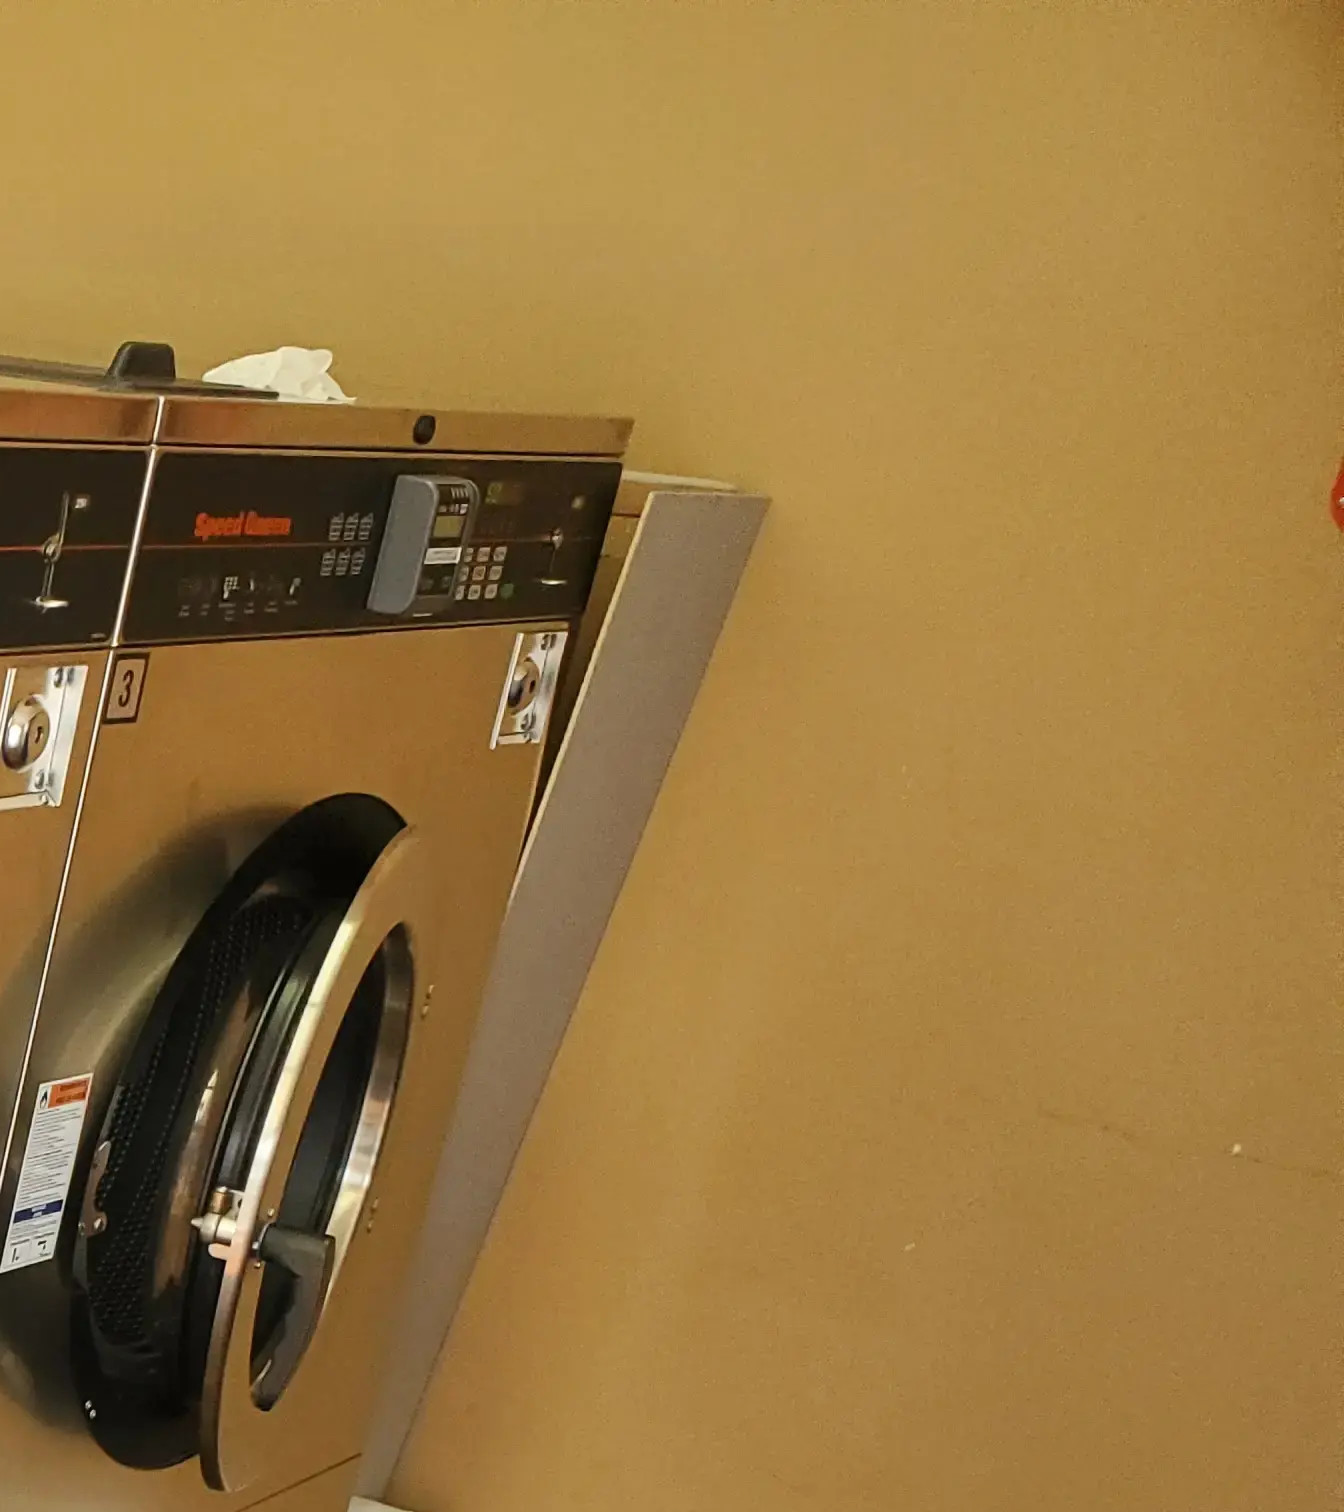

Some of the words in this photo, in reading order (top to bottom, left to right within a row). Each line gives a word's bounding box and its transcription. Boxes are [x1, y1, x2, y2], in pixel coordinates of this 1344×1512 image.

[194, 510, 244, 541] Speed
[244, 510, 292, 536] Queen
[118, 670, 134, 707] 3
